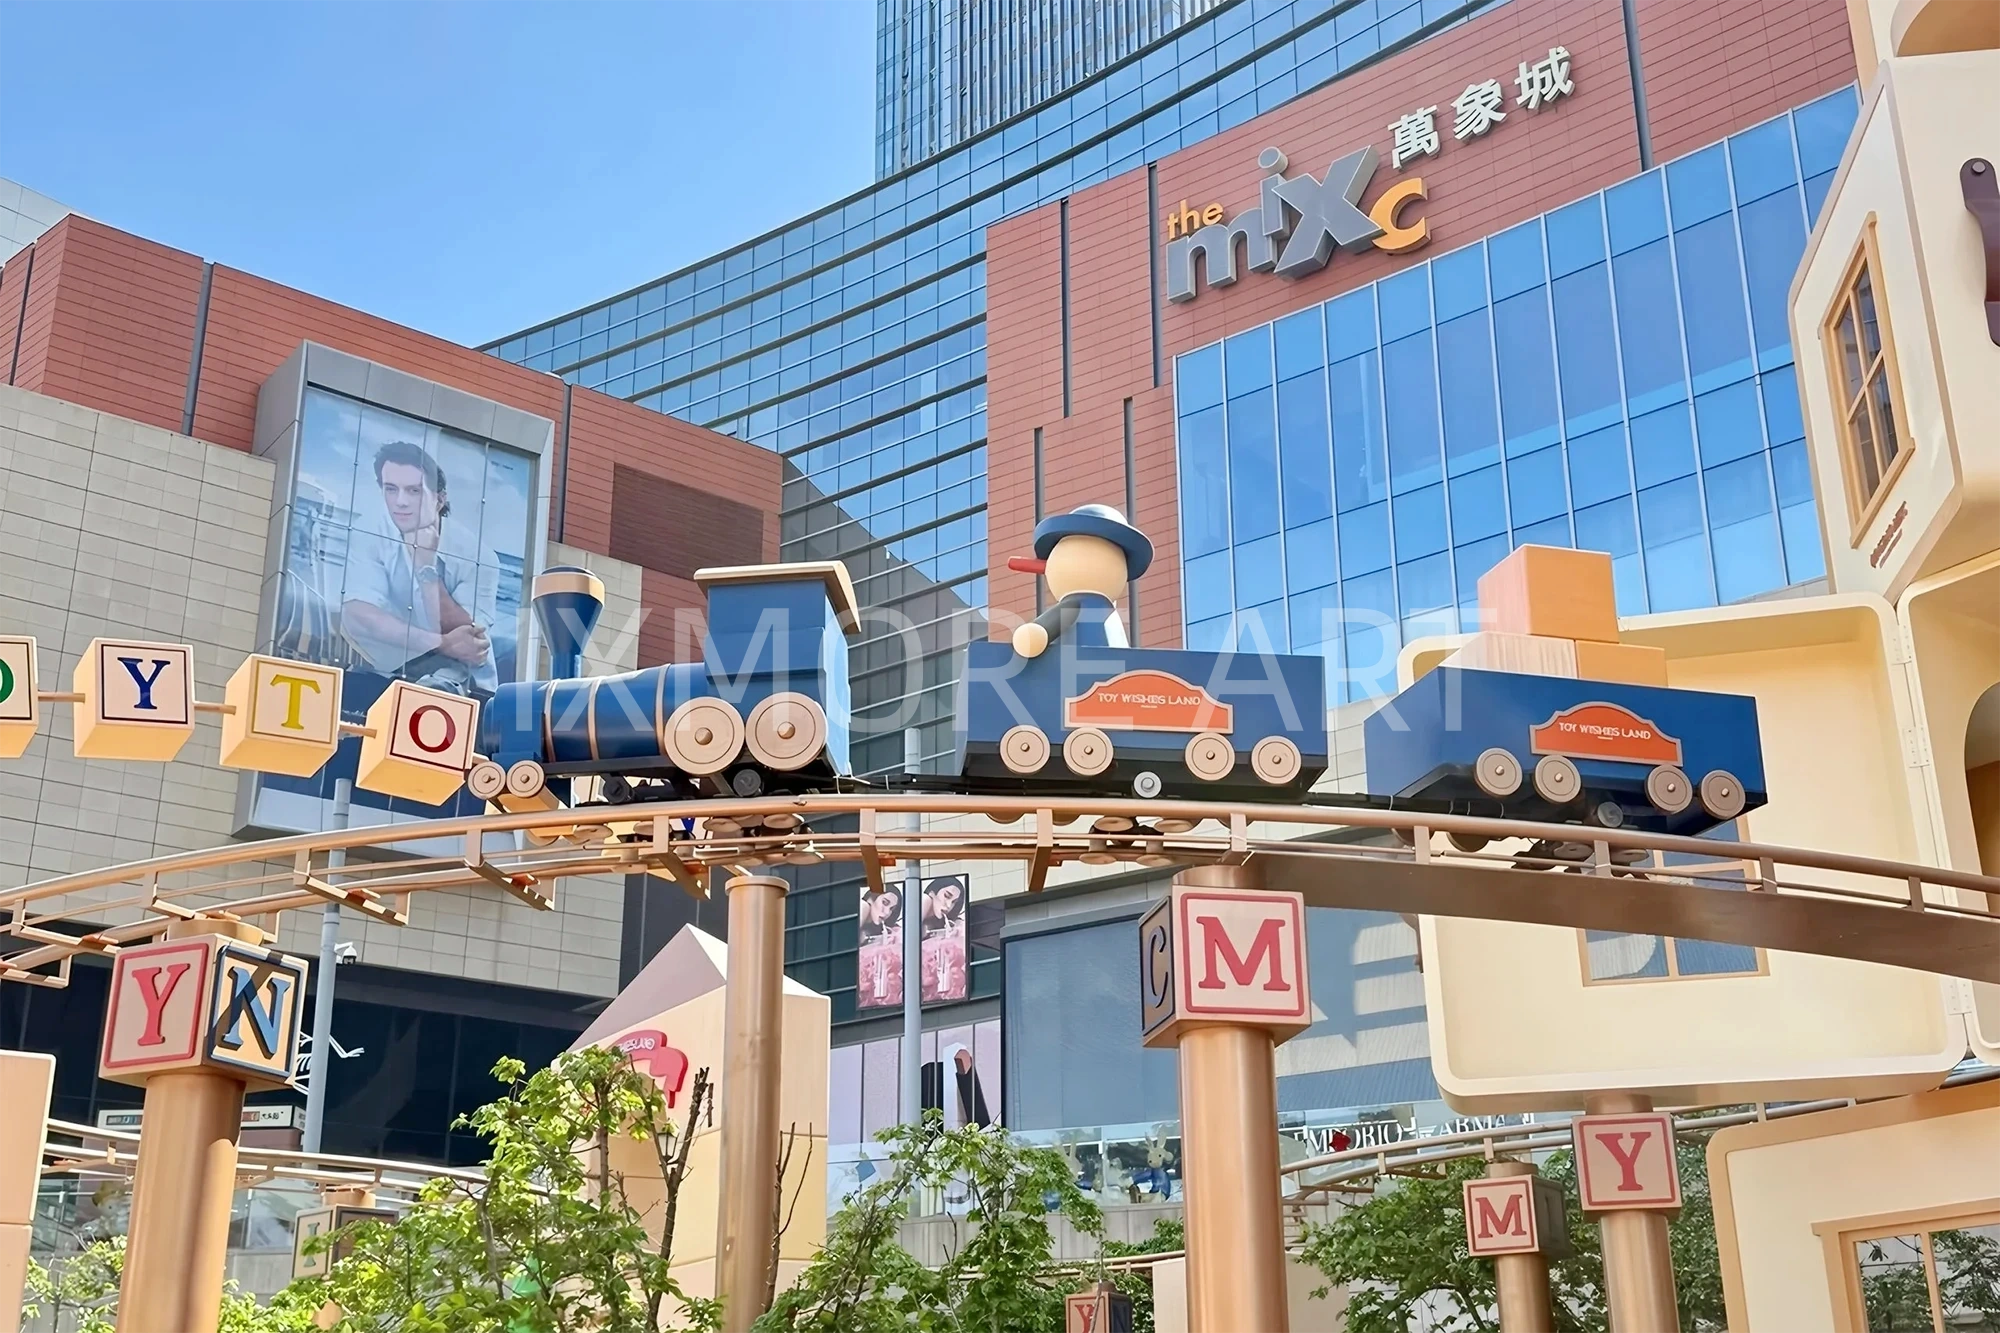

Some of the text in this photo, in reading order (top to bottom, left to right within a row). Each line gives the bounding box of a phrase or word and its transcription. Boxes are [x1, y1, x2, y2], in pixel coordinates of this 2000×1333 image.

[1387, 45, 1576, 169] 萬象城
[1167, 199, 1224, 241] the
[117, 656, 457, 754] Y T O
[1098, 692, 1119, 704] TOY
[1168, 695, 1201, 706] LAND
[1559, 722, 1577, 733] TOY
[1621, 728, 1651, 740] LAND
[1196, 915, 1291, 992] M
[131, 963, 191, 1047] Y
[222, 966, 291, 1059] N
[1595, 1131, 1651, 1191] Y
[1475, 1194, 1527, 1239] M
